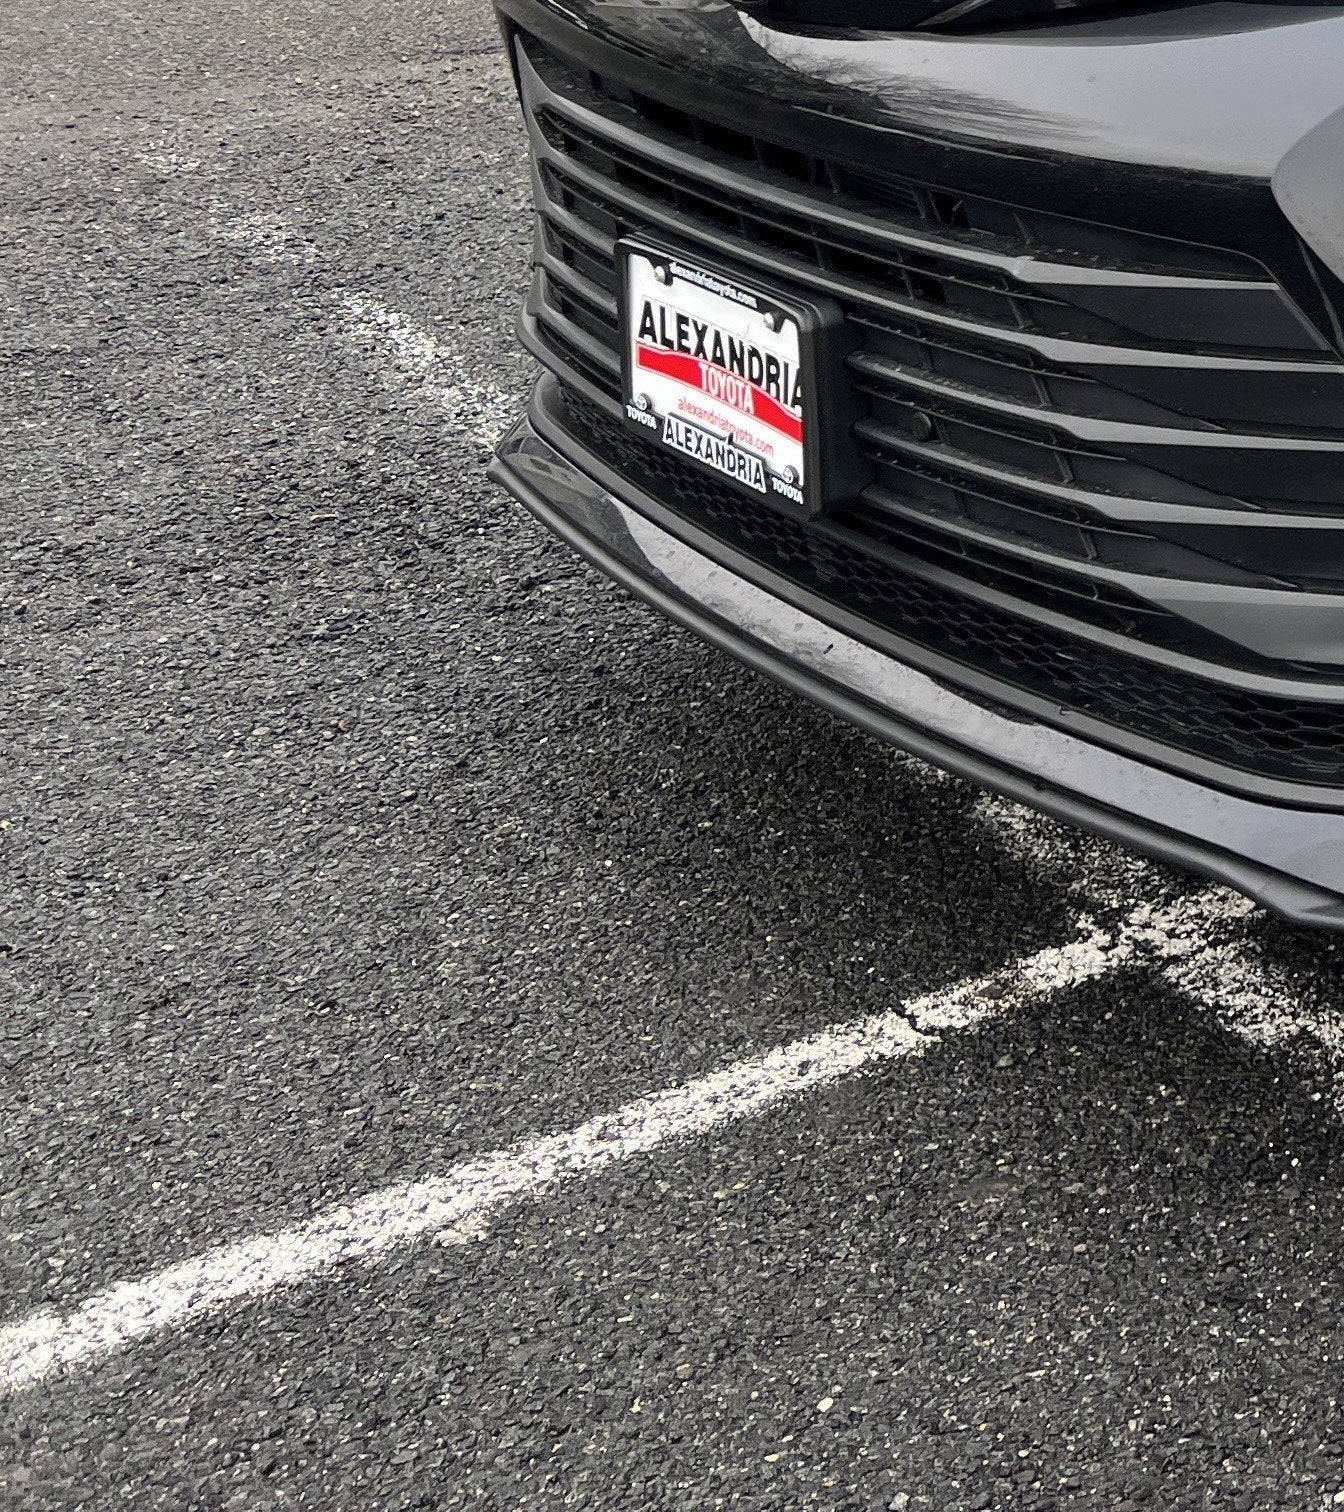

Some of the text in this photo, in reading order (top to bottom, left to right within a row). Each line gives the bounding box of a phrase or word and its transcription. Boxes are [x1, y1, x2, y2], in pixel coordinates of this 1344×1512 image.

[638, 300, 802, 409] ALEXANDRIA
[626, 404, 658, 430] TOYOTA
[699, 363, 755, 416] TOYOTA
[663, 416, 767, 493] ALEXANDRIA
[677, 397, 775, 457] alexandriatoyota.com
[772, 476, 804, 505] TOYOTA
